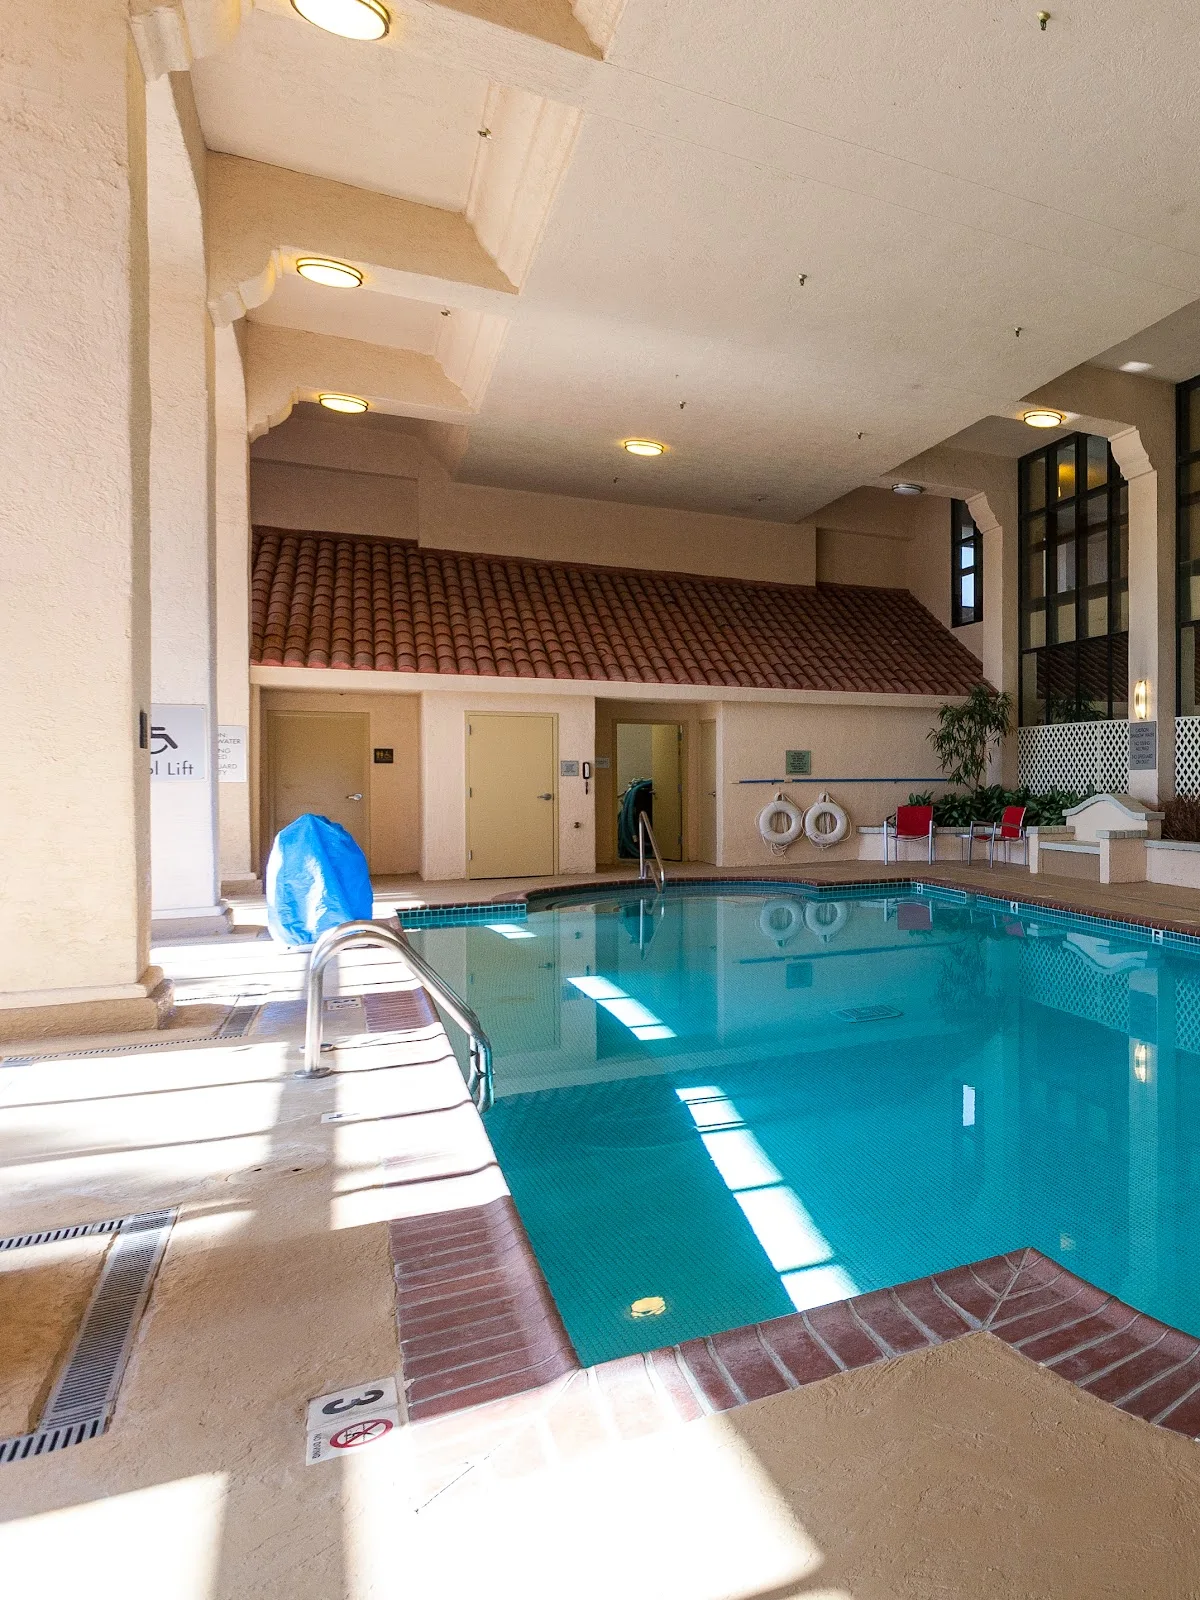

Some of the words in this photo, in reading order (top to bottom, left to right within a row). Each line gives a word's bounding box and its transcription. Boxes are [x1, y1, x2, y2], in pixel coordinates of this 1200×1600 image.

[168, 760, 194, 775] Lift
[322, 1389, 384, 1415] 3
[312, 1441, 321, 1459] DIVING
